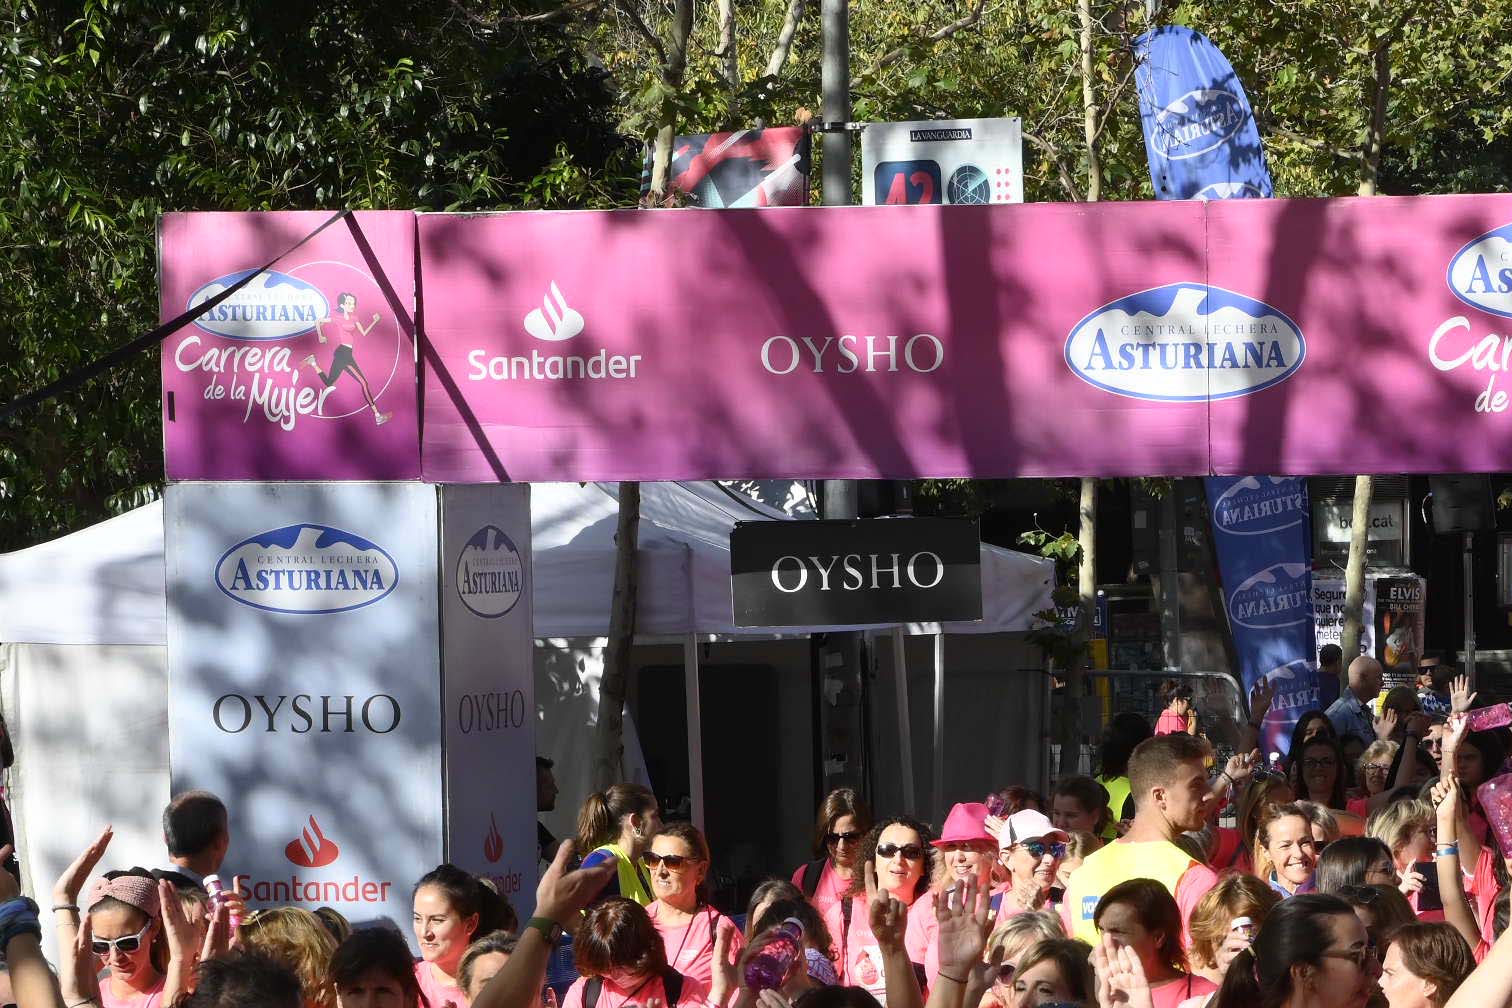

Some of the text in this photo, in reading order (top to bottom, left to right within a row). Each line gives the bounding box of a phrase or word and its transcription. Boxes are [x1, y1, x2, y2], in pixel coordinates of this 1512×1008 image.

[921, 129, 970, 139] VANGUARDIA
[200, 295, 318, 322] ASTURIANA
[1121, 323, 1279, 335] CENTRAL LECHERA
[174, 335, 292, 373] Carrera
[468, 349, 641, 379] Santander
[761, 333, 944, 374] OYSHO
[1085, 328, 1288, 370] ASTURIANA
[203, 369, 337, 431] de la Mujer
[1475, 375, 1508, 413] de
[230, 558, 385, 591] ASTURIANA
[257, 555, 379, 564] CENTRAL LECHERA
[771, 550, 944, 594] OYSHO
[462, 560, 520, 594] ASTURIANA
[1389, 587, 1421, 600] ELVIS
[212, 694, 400, 733] OYSHO
[458, 689, 525, 734] OYSHO
[236, 874, 391, 903] Santander
